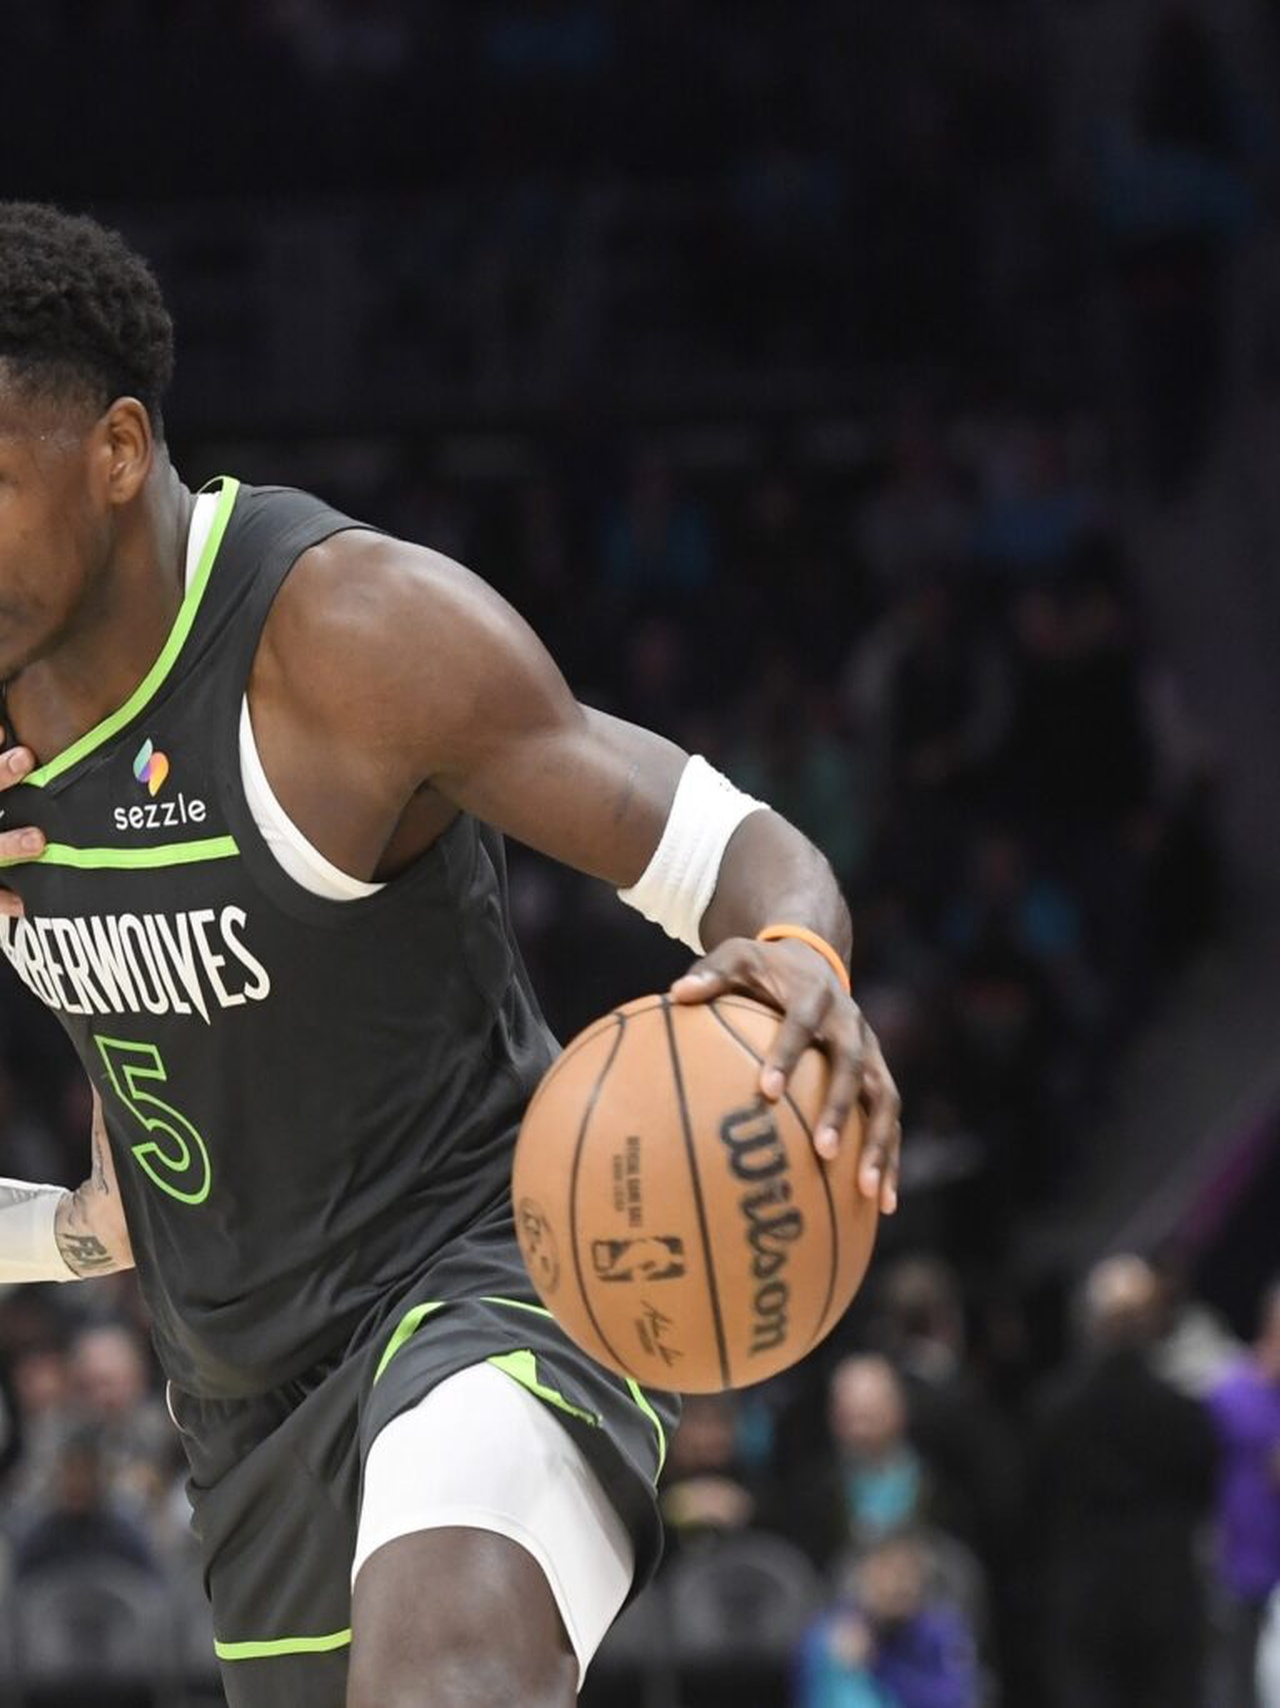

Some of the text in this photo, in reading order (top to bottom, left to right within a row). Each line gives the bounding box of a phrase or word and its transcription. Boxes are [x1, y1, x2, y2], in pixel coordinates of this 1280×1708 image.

[113, 793, 207, 831] sezzle
[93, 1033, 213, 1206] 5
[719, 1097, 803, 1356] Wilson
